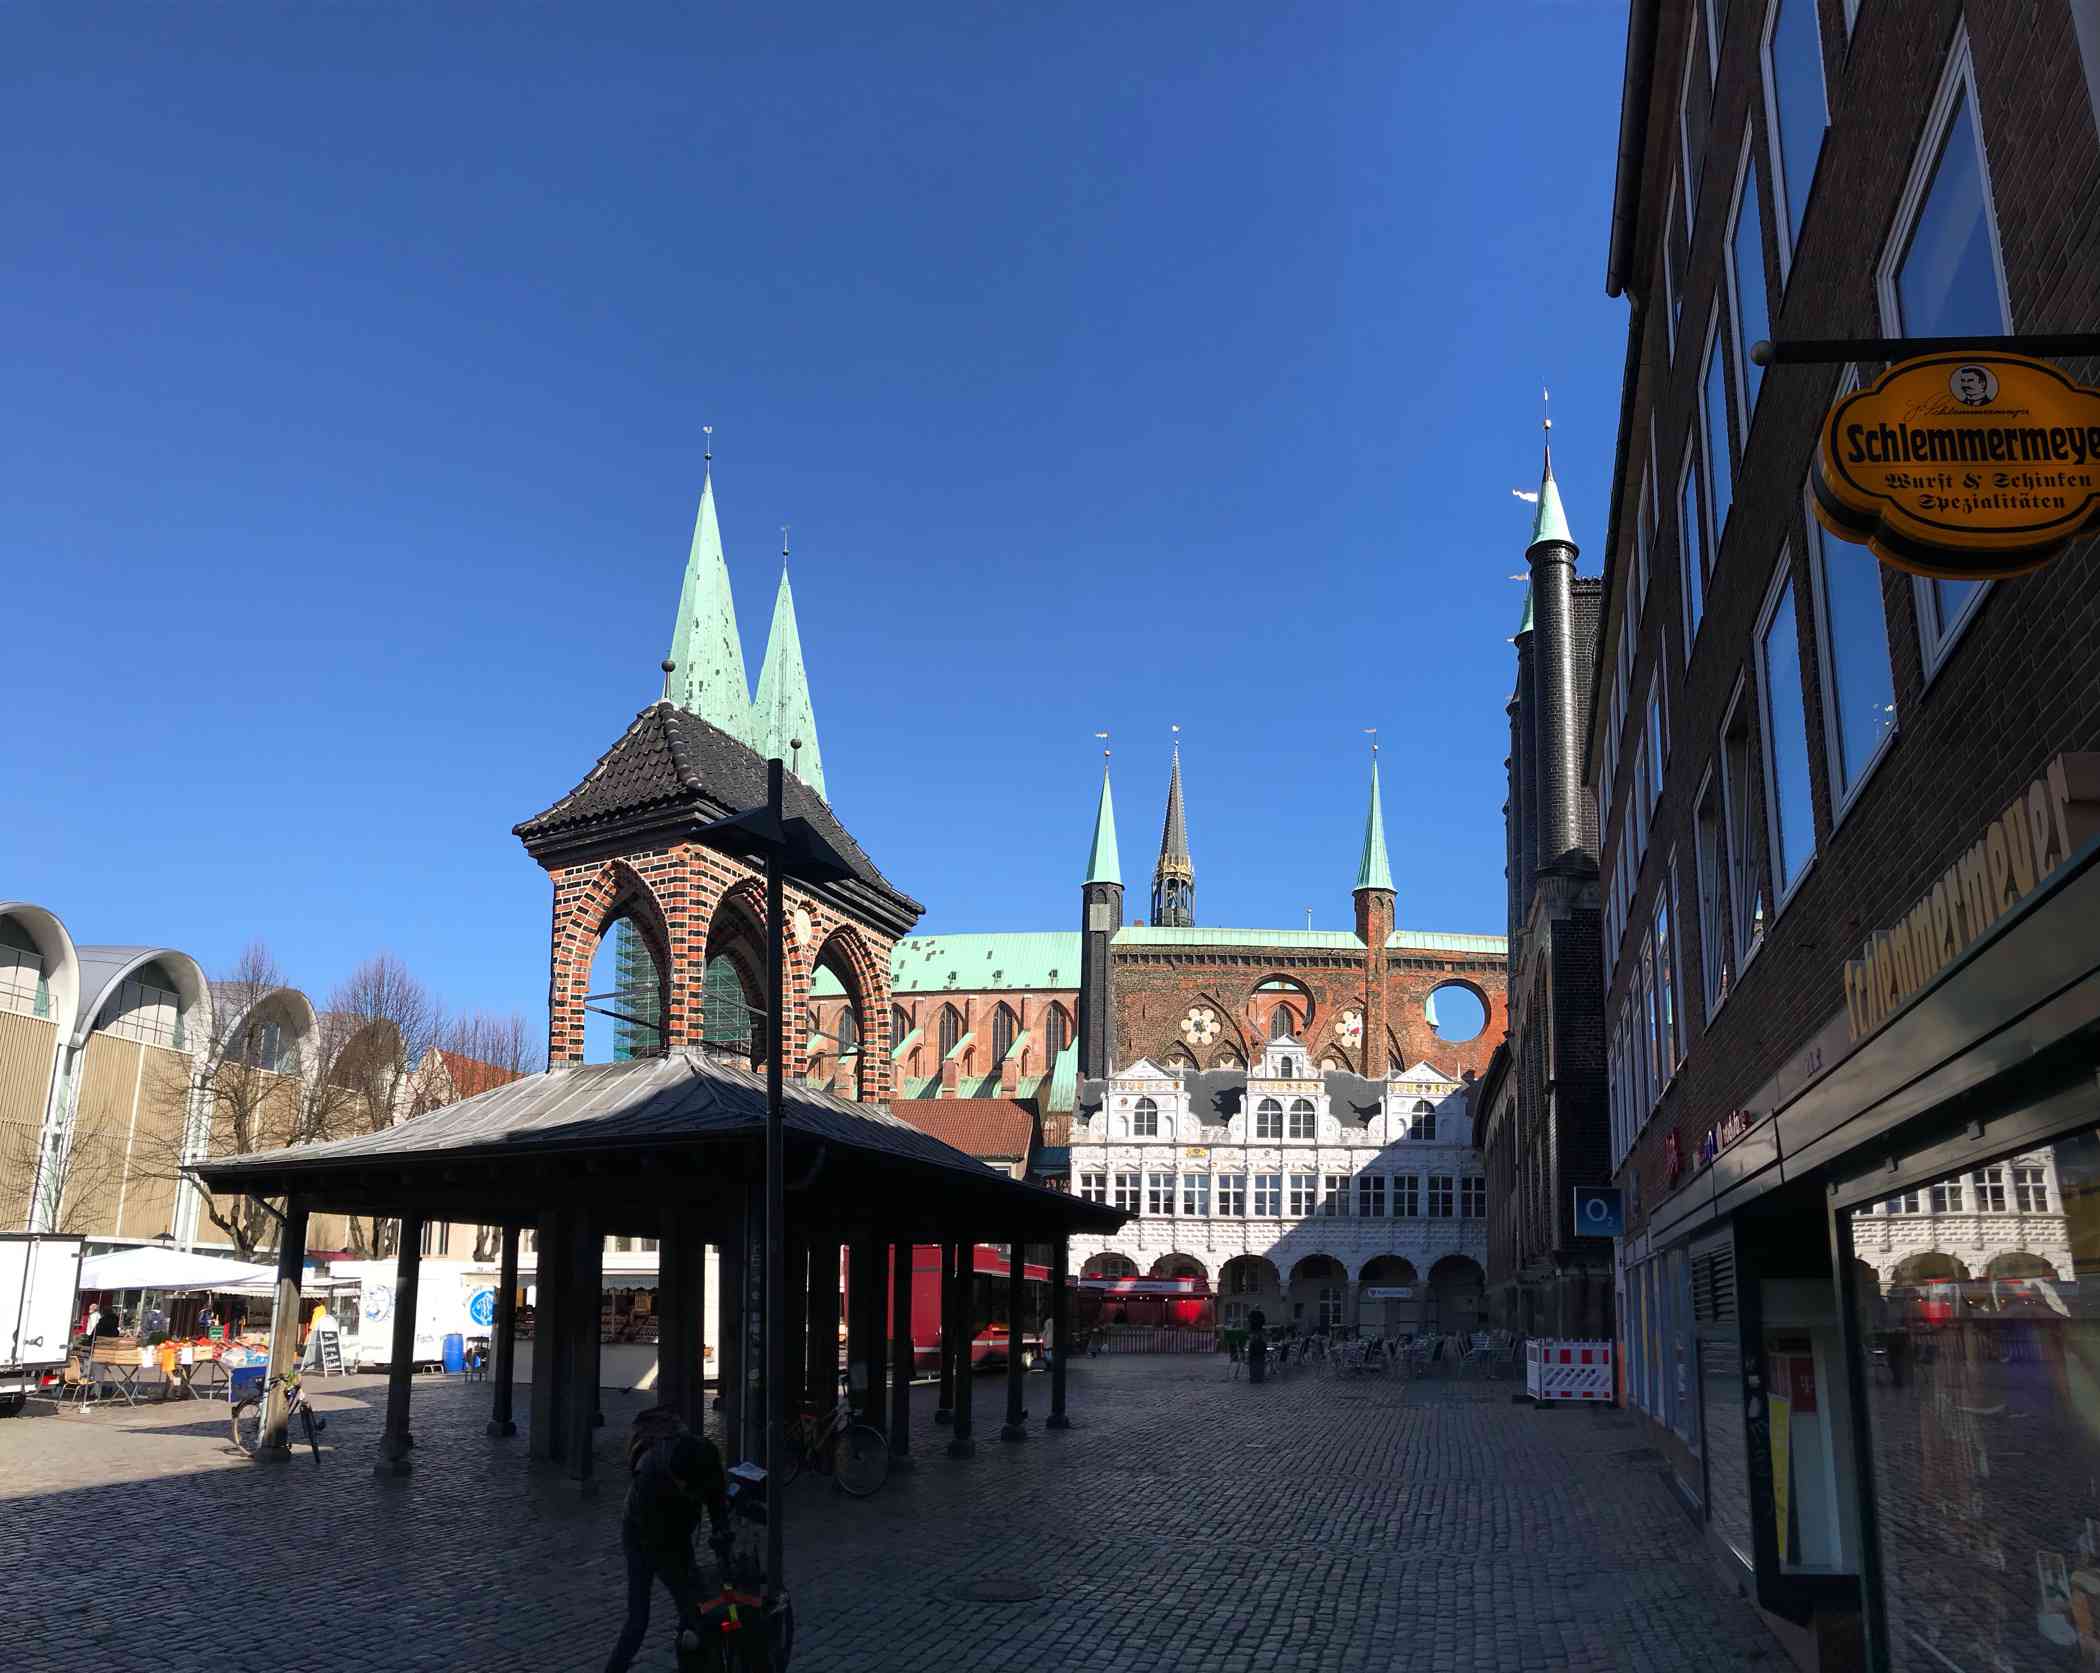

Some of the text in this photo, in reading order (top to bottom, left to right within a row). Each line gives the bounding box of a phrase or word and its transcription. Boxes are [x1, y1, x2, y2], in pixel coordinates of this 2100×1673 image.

[1846, 422, 2100, 465] Schlemmermeye
[1962, 472, 1983, 489] &
[1992, 472, 2093, 491] Schinken
[1918, 492, 2066, 514] Spezialitäten
